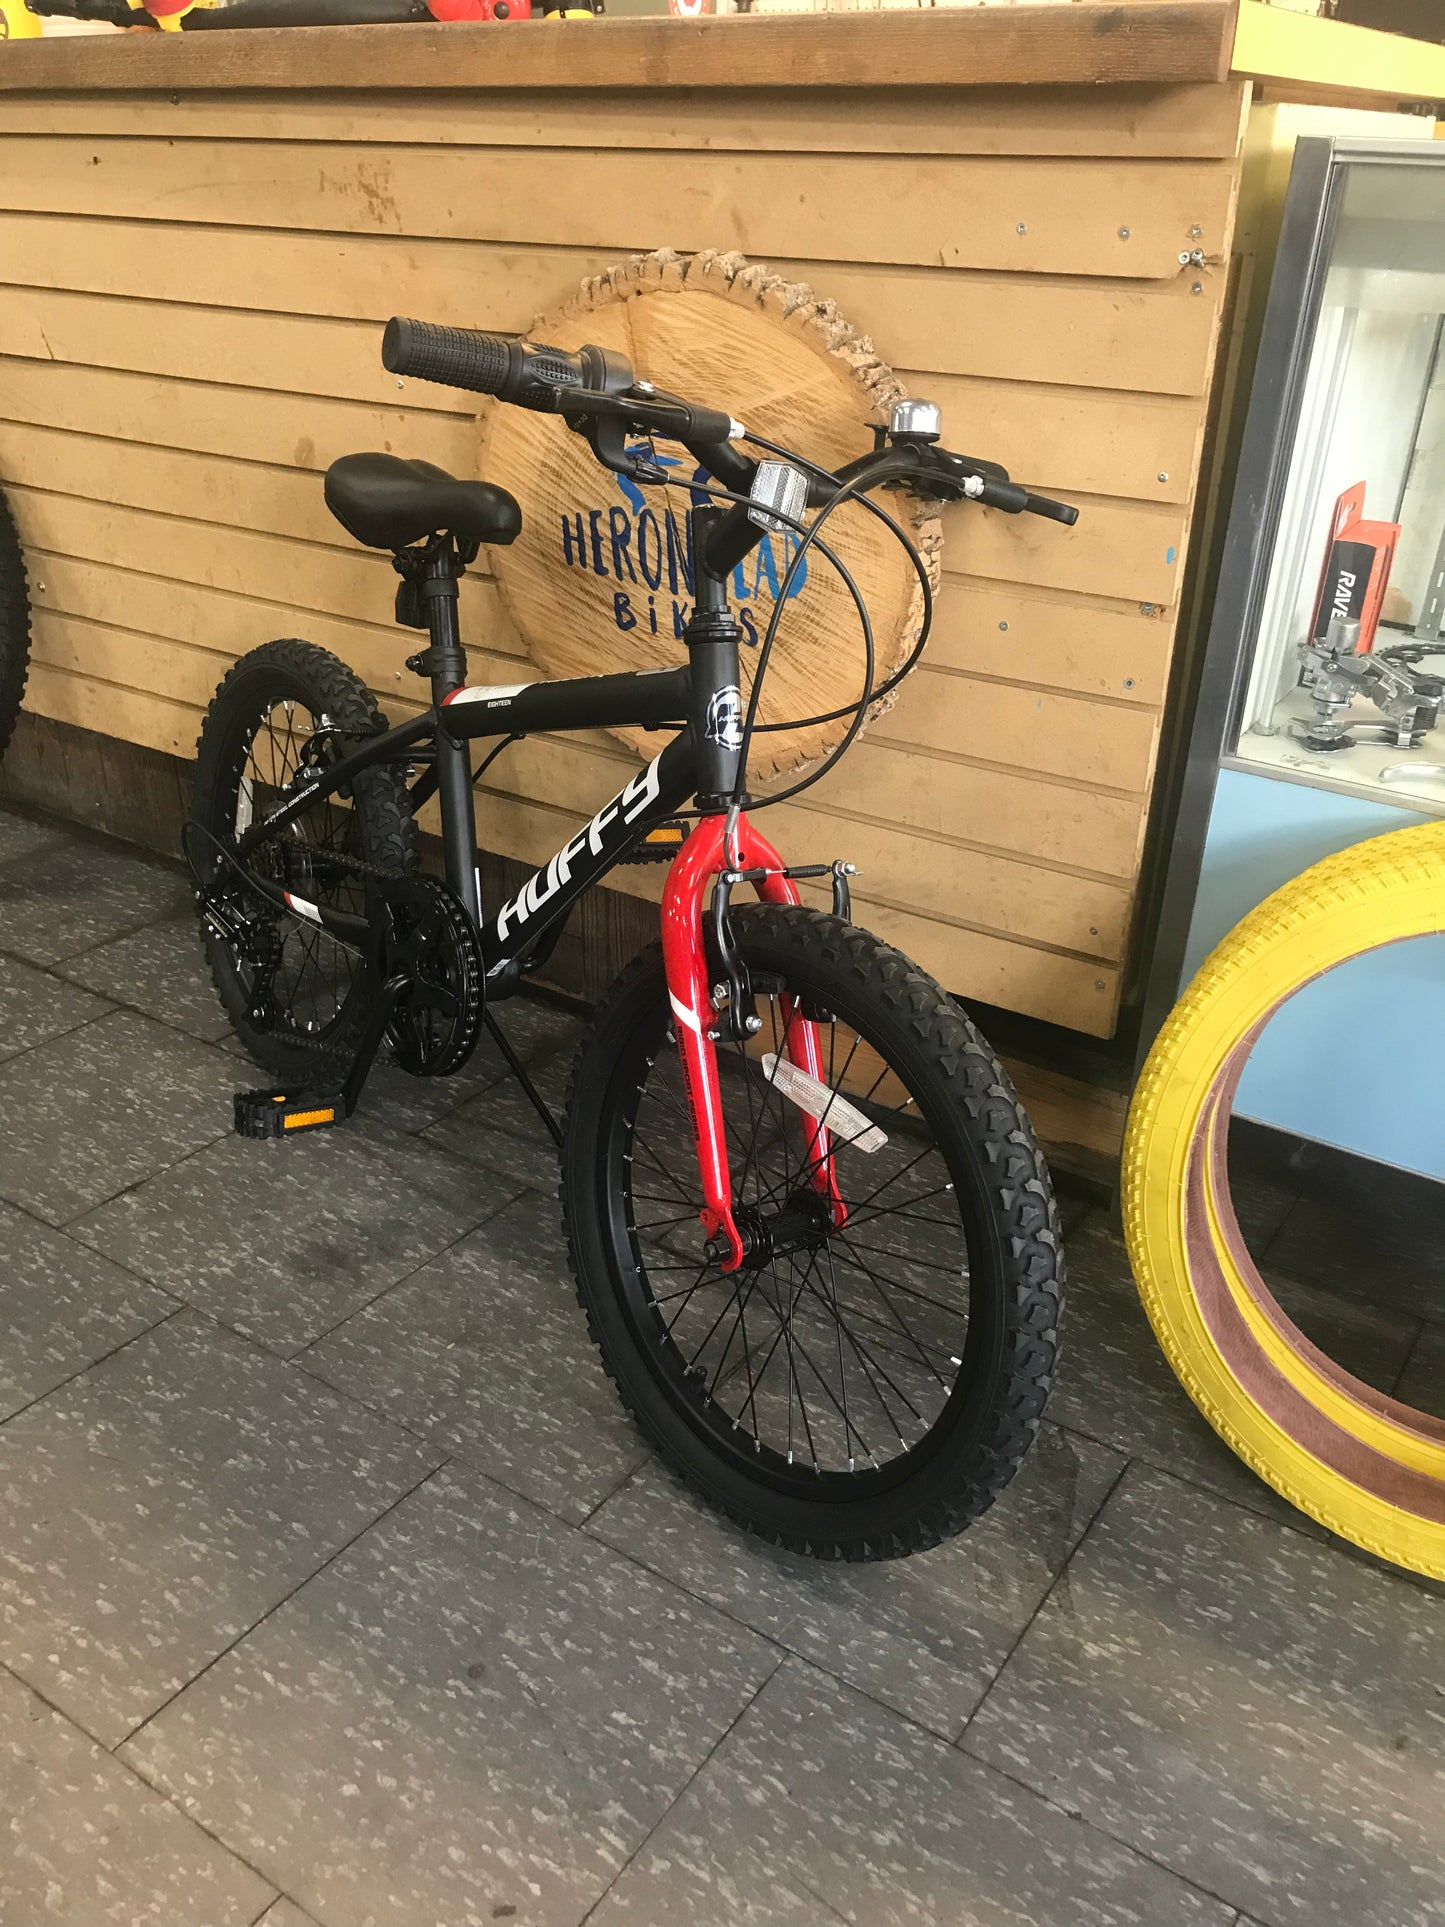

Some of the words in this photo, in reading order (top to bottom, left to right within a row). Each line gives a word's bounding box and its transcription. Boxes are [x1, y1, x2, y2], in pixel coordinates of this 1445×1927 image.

[562, 506, 695, 597] HERON
[613, 592, 759, 648] BiKS
[487, 699, 512, 709] EIGHTEEN
[288, 782, 320, 807] CONSTRUCTION
[496, 751, 661, 942] HUFFY
[677, 1025, 687, 1056] RIGID
[683, 1059, 694, 1097] SPORT
[688, 1100, 701, 1141] SERIES
